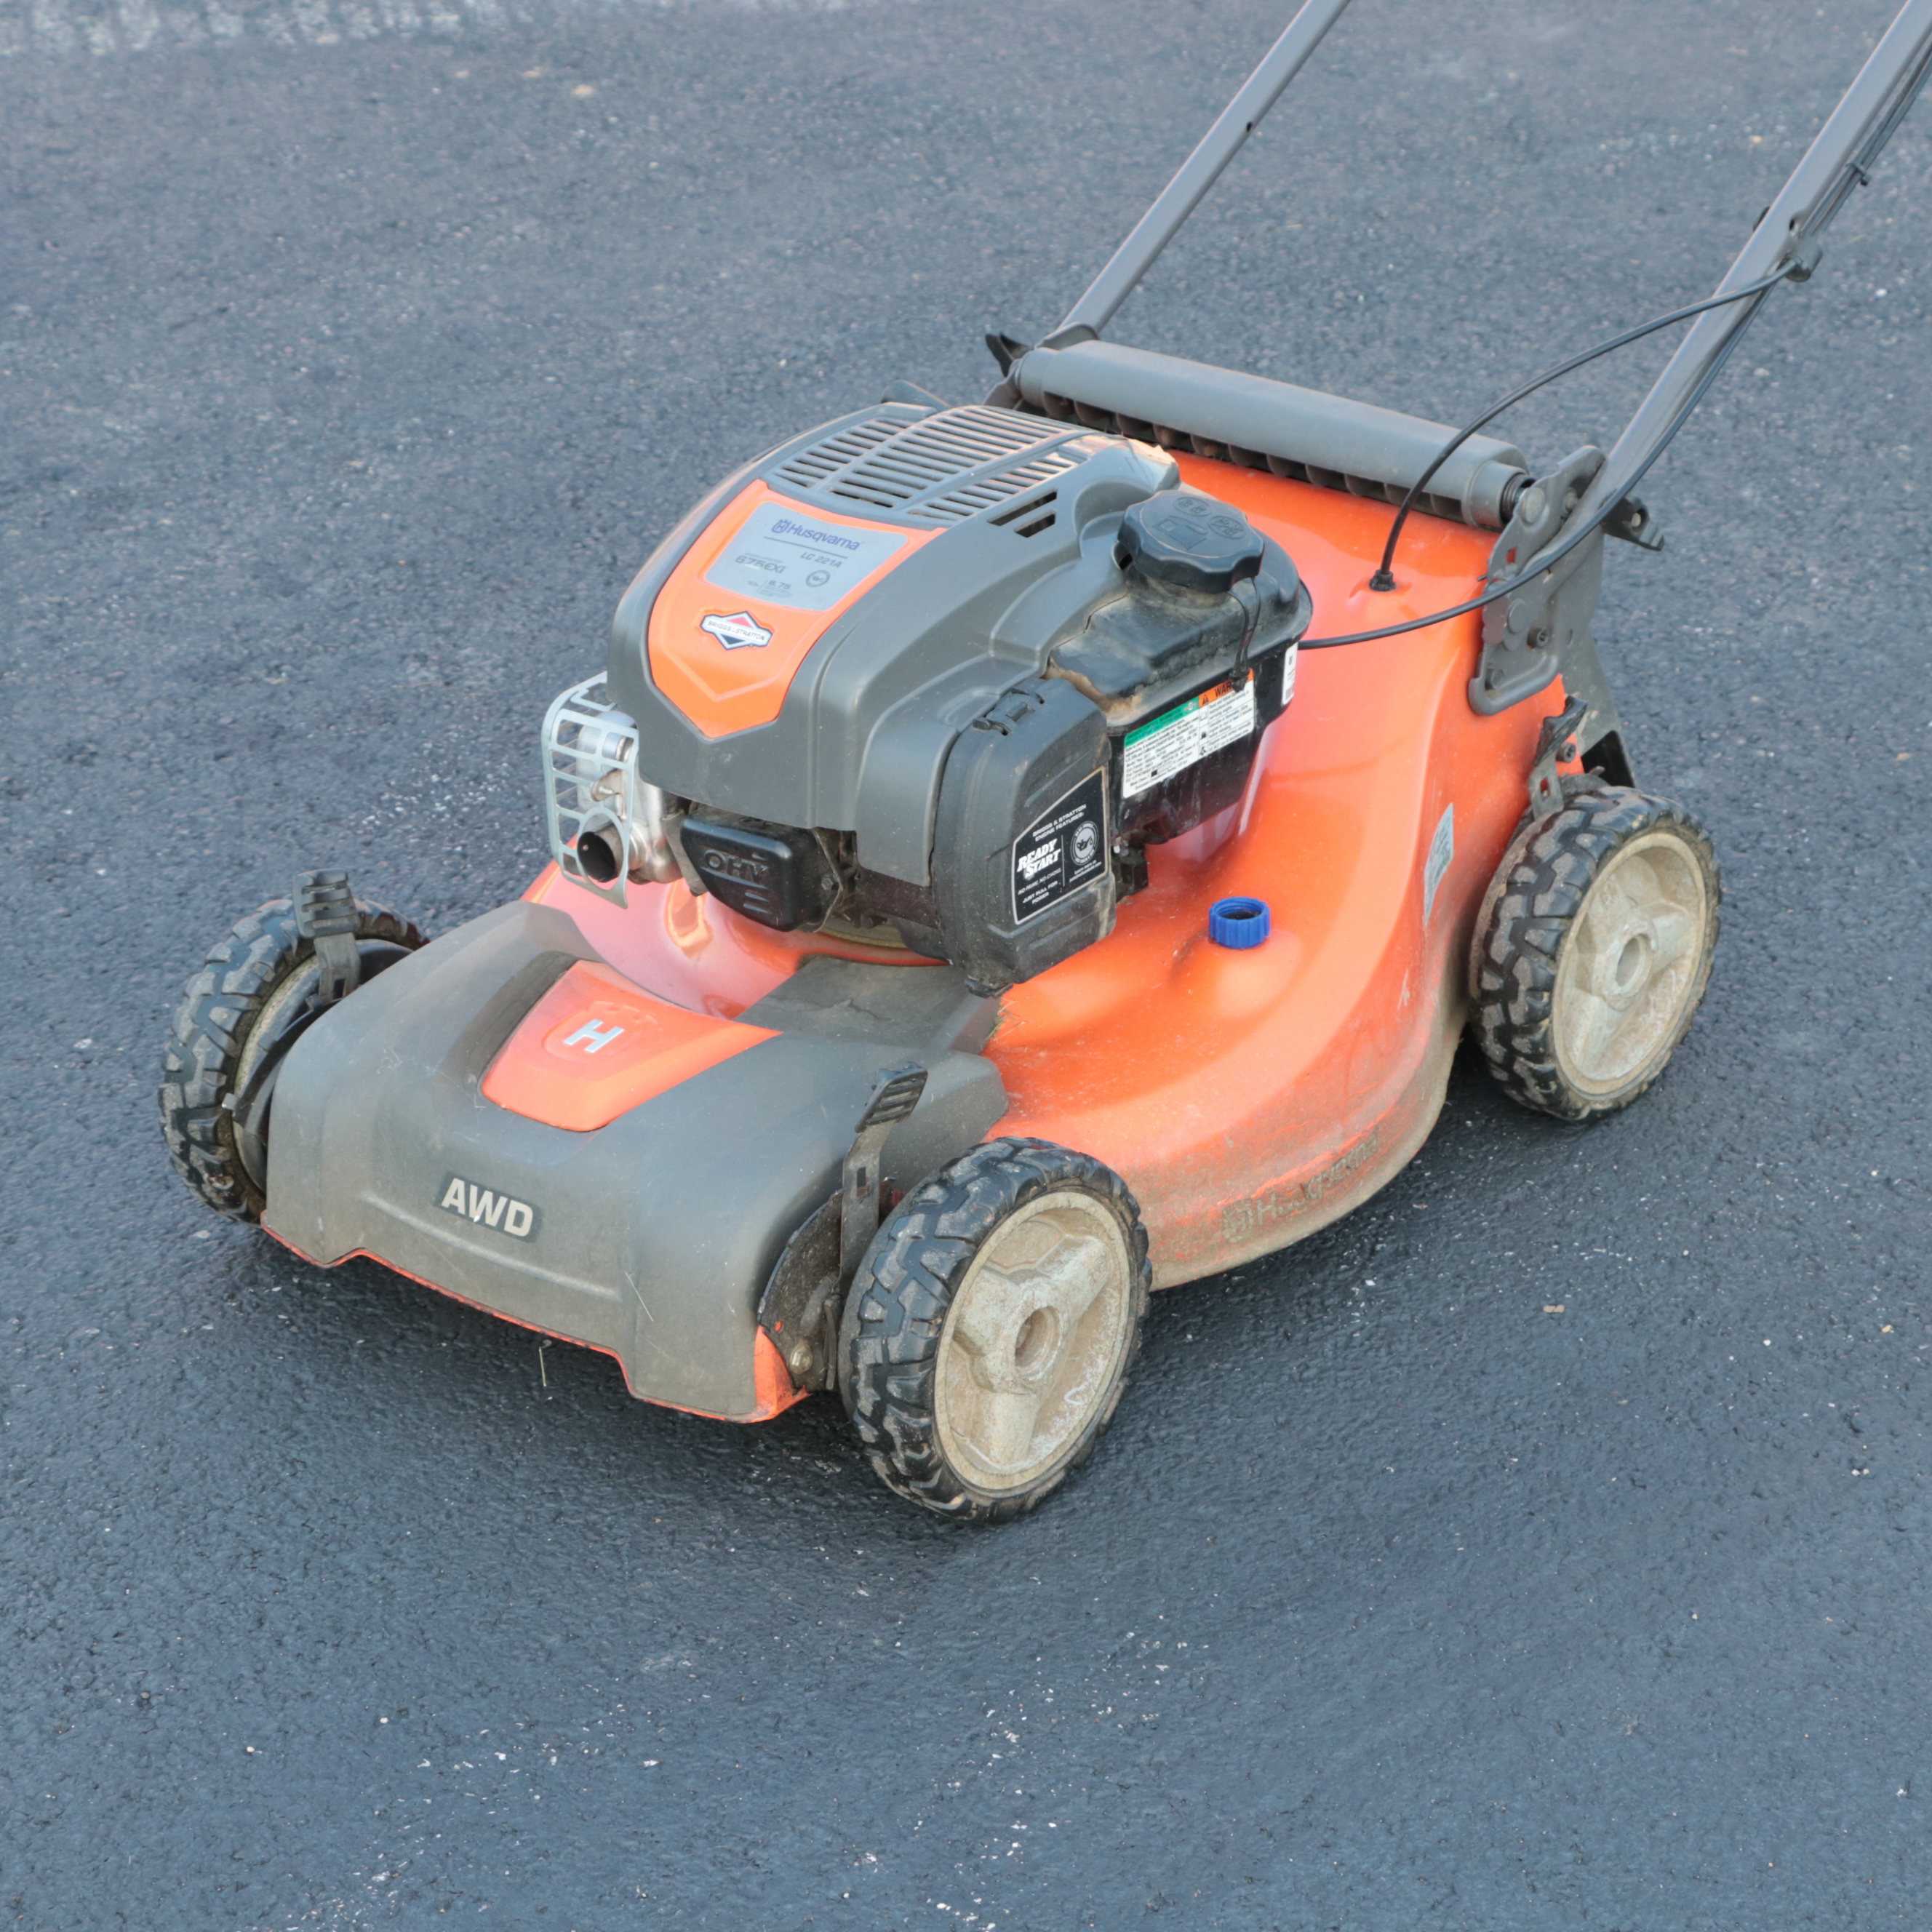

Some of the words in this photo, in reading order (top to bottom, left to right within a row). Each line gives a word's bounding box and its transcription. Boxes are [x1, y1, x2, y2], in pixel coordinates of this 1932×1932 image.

[786, 523, 860, 550] Husqvarna
[800, 552, 815, 560] LC
[815, 556, 842, 568] 221A
[707, 620, 732, 631] BRIGGS
[735, 628, 766, 641] STRATTON
[1033, 823, 1053, 837] BRIGGS
[1058, 804, 1087, 823] STRATTON
[1035, 827, 1055, 842] ENGINE
[703, 849, 768, 883] OHV
[1017, 839, 1058, 872] READY
[1024, 849, 1061, 879] START
[1023, 893, 1034, 903] JUST
[1036, 887, 1047, 896] PULL
[1048, 881, 1058, 889] FOR
[1032, 892, 1049, 904] POWER
[562, 1018, 625, 1053] H
[441, 1178, 533, 1237] AWD
